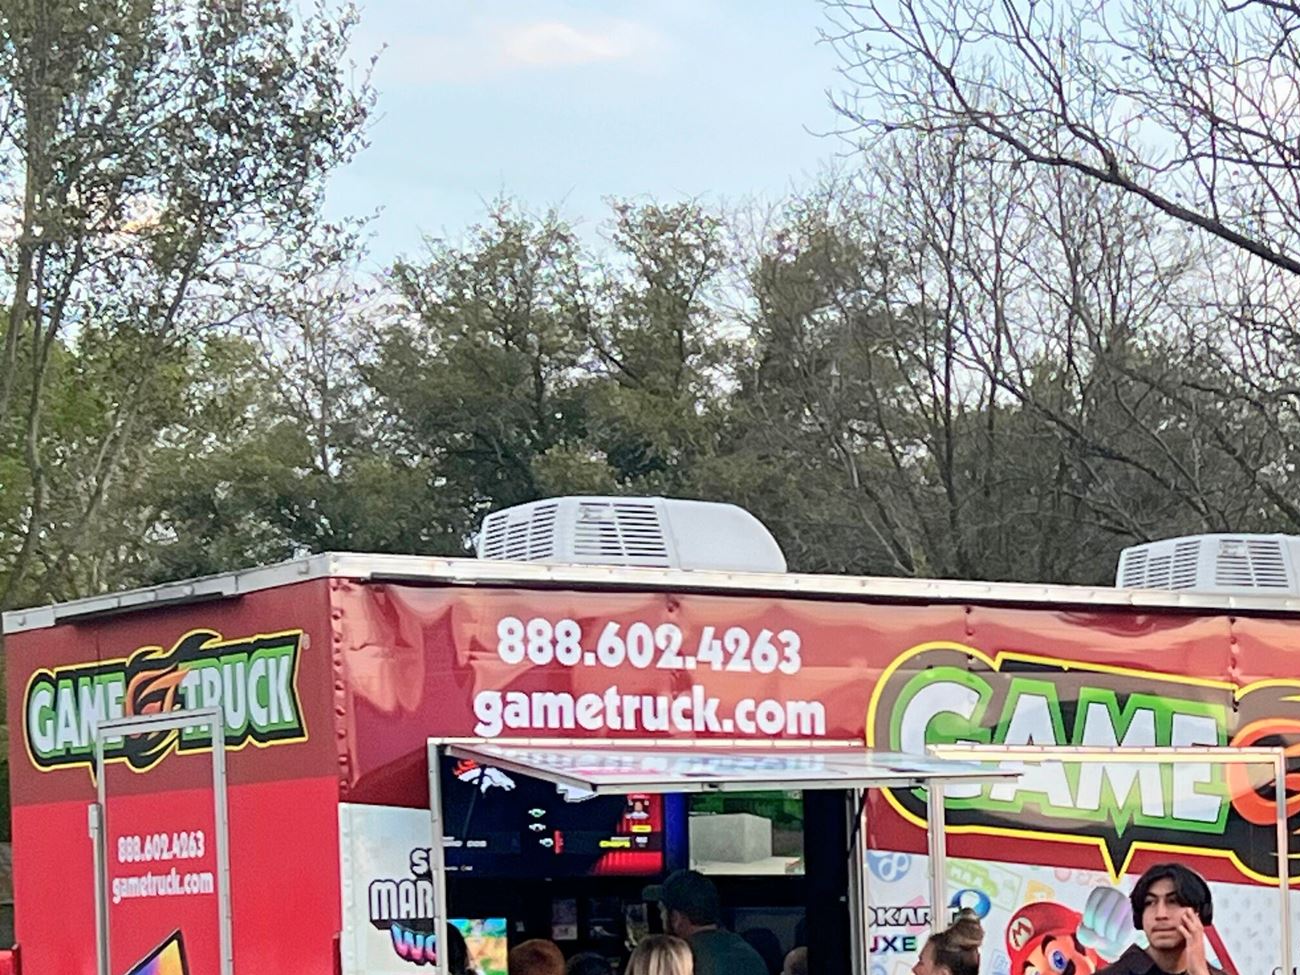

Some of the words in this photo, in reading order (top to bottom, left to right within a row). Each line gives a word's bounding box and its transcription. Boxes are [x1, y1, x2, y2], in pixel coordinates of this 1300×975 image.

[497, 616, 801, 675] 888.602.4263
[29, 679, 125, 754] GAME
[181, 653, 296, 734] TRUCK
[473, 684, 826, 738] gametruck.com
[898, 679, 1225, 823] GAME
[117, 830, 206, 863] 888.602.4263
[112, 866, 214, 904] gametruck.com
[370, 879, 434, 920] MAR
